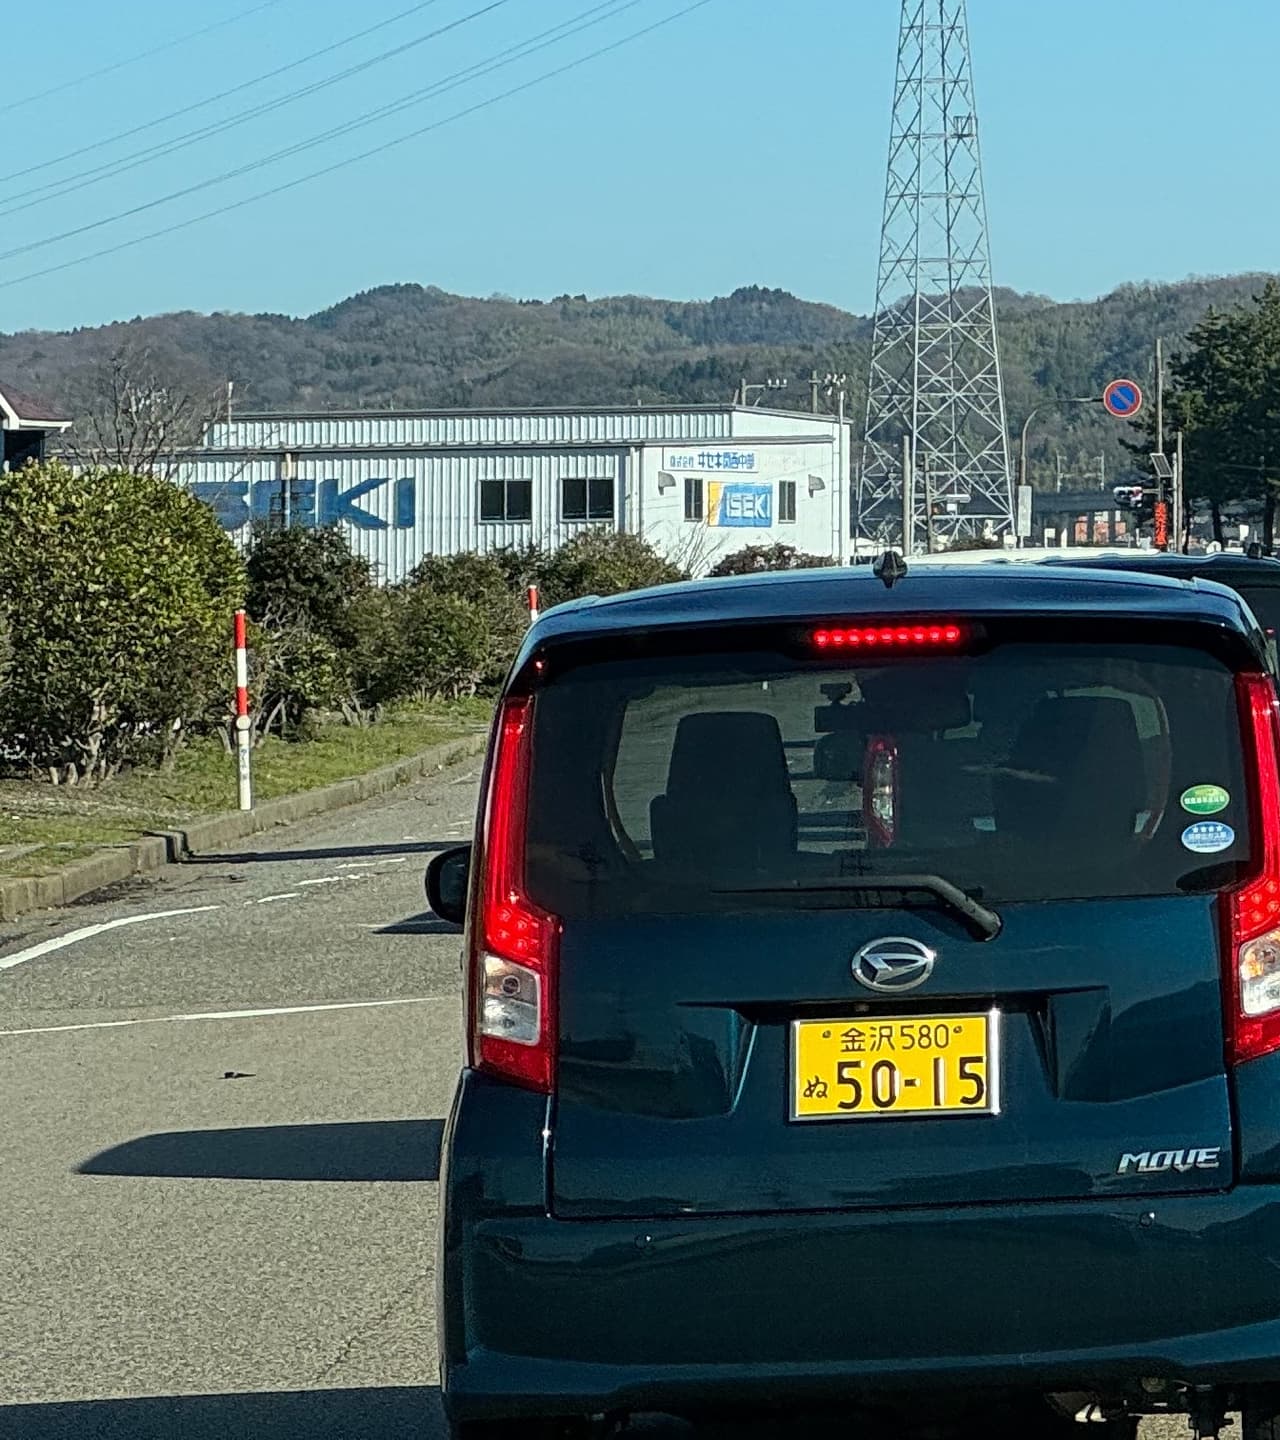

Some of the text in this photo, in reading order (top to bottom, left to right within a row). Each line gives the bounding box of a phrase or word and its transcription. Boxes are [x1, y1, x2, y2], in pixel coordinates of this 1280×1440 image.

[840, 1023, 950, 1053] 金沢580
[803, 1055, 986, 1110] ぬ 50-15
[1116, 1146, 1221, 1174] MOVE
